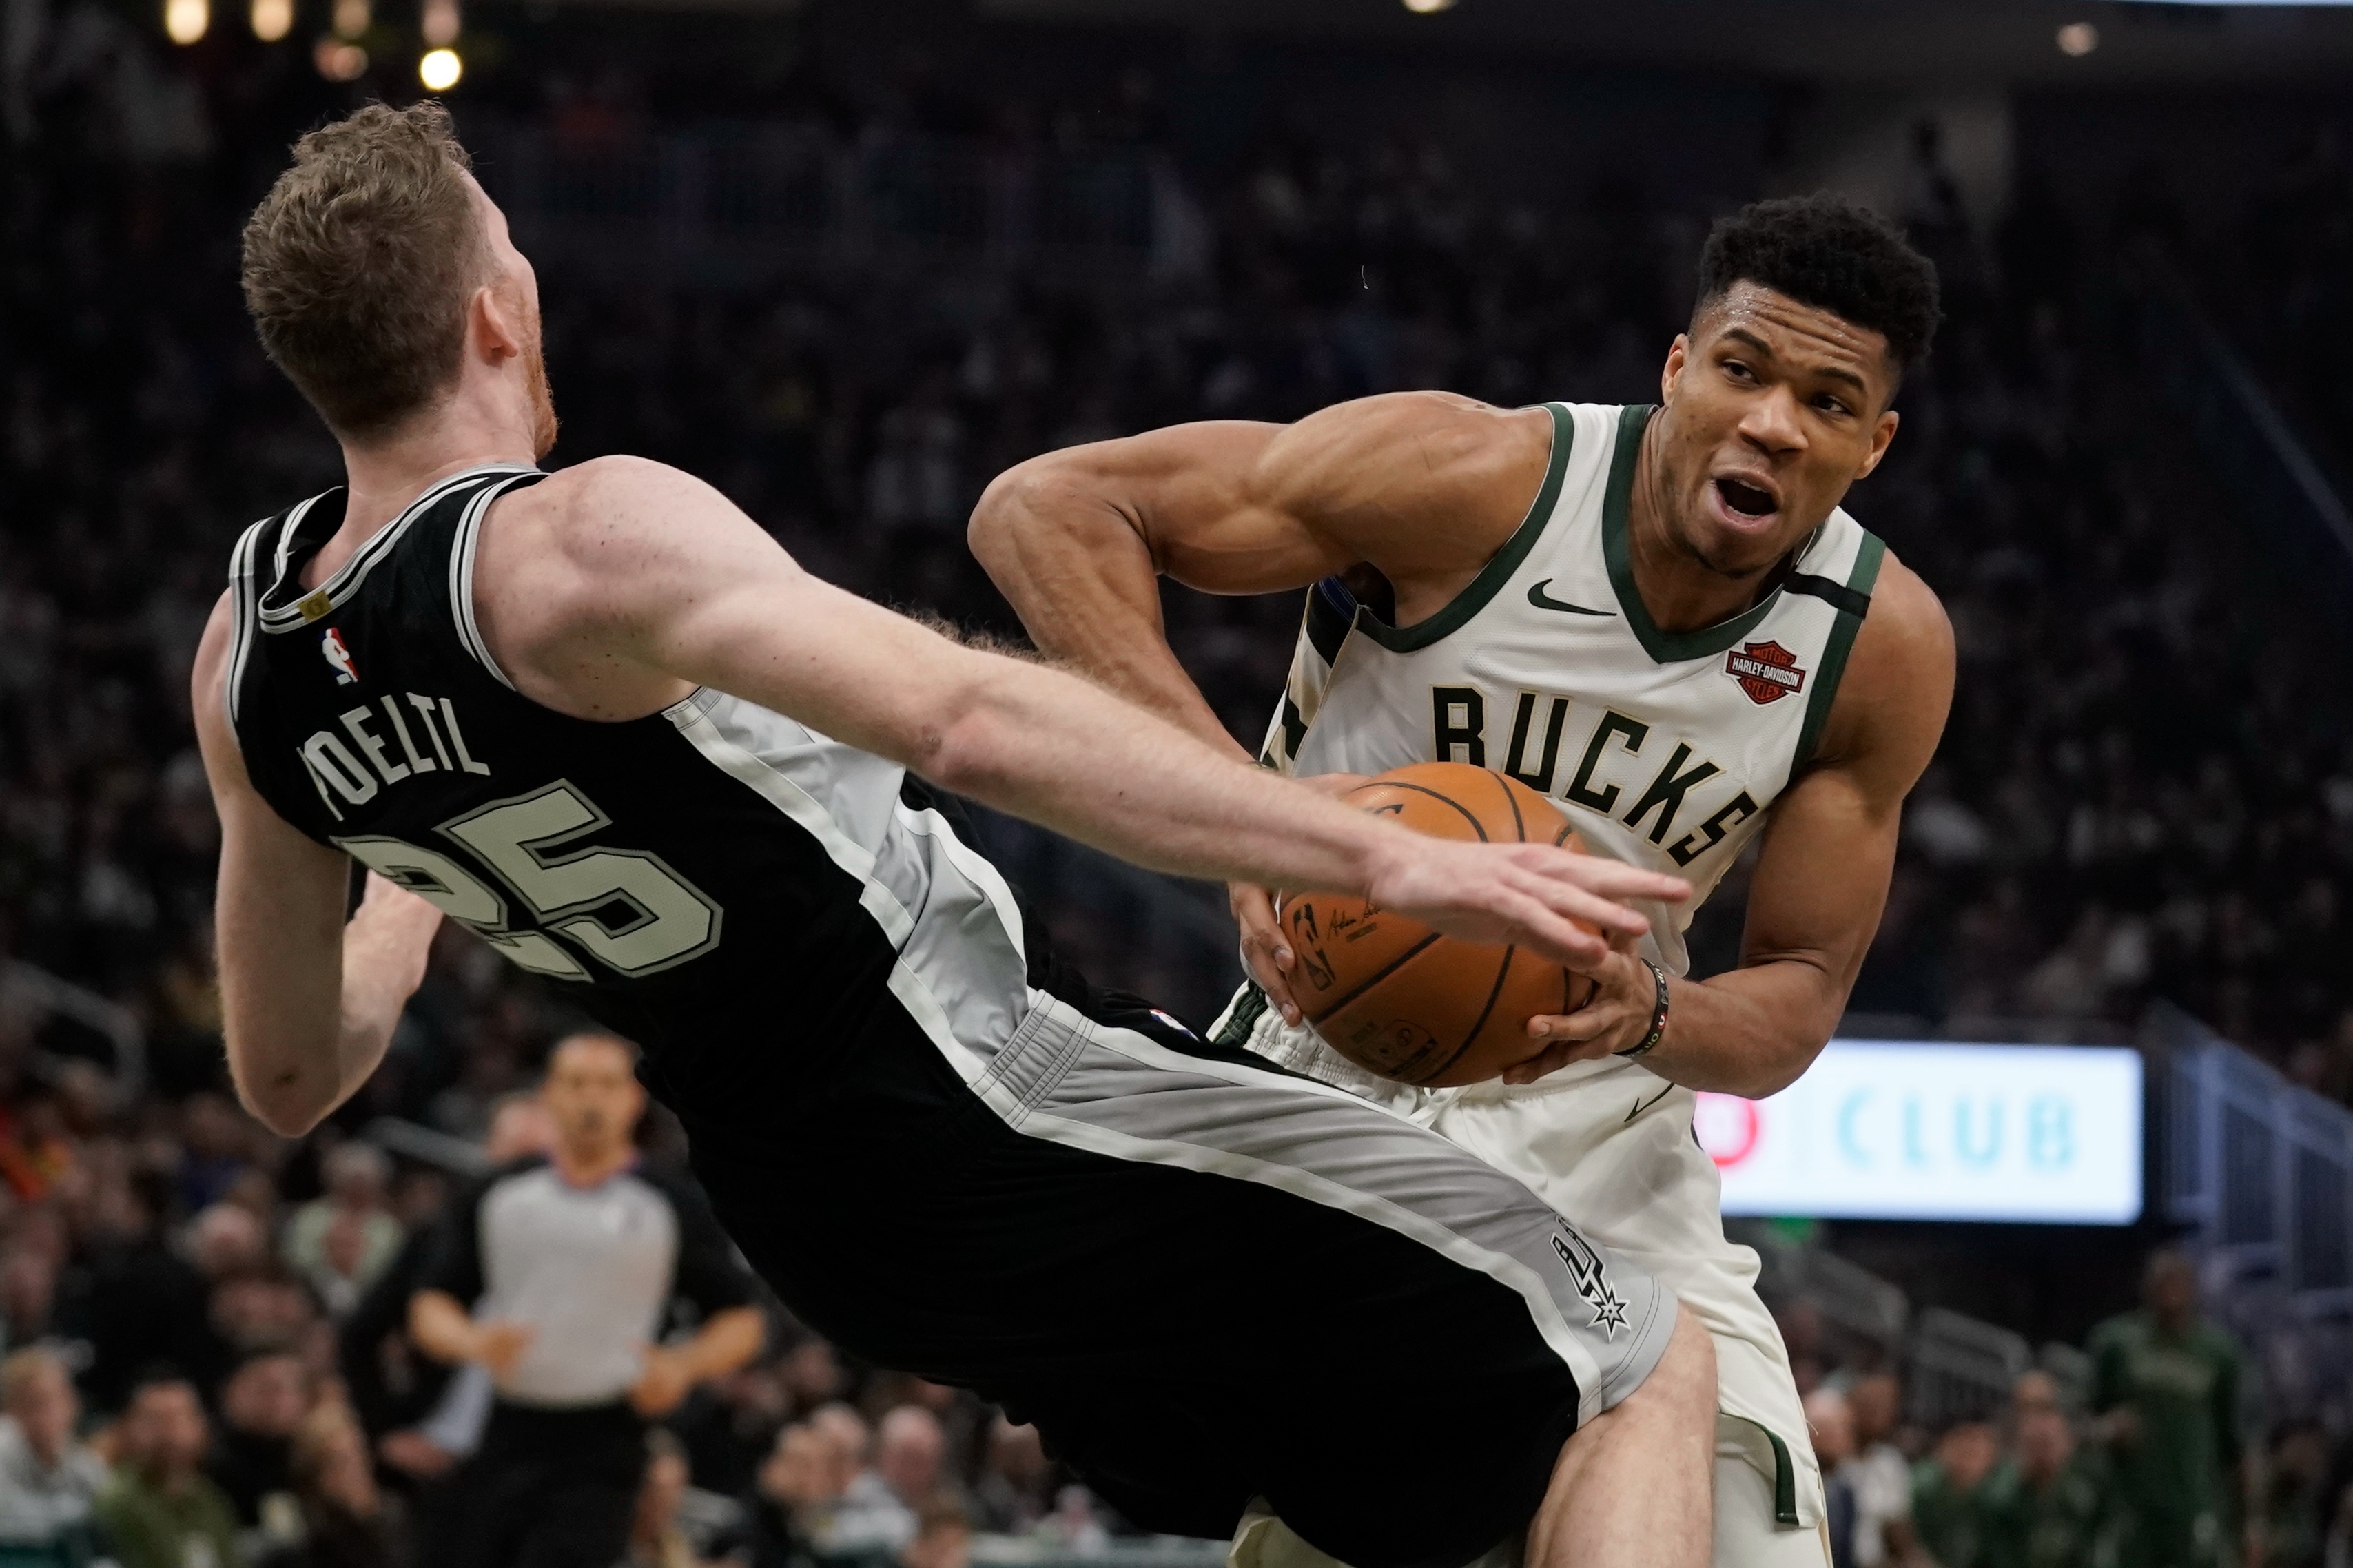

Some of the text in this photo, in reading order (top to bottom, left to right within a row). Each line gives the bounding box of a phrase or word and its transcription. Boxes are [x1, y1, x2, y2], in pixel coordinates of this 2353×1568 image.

[1732, 657, 1800, 688] HARLEY-DAVIDSON
[1430, 684, 1763, 871] BUCKS
[329, 778, 724, 984] 25
[1838, 1087, 2077, 1171] CLUB
